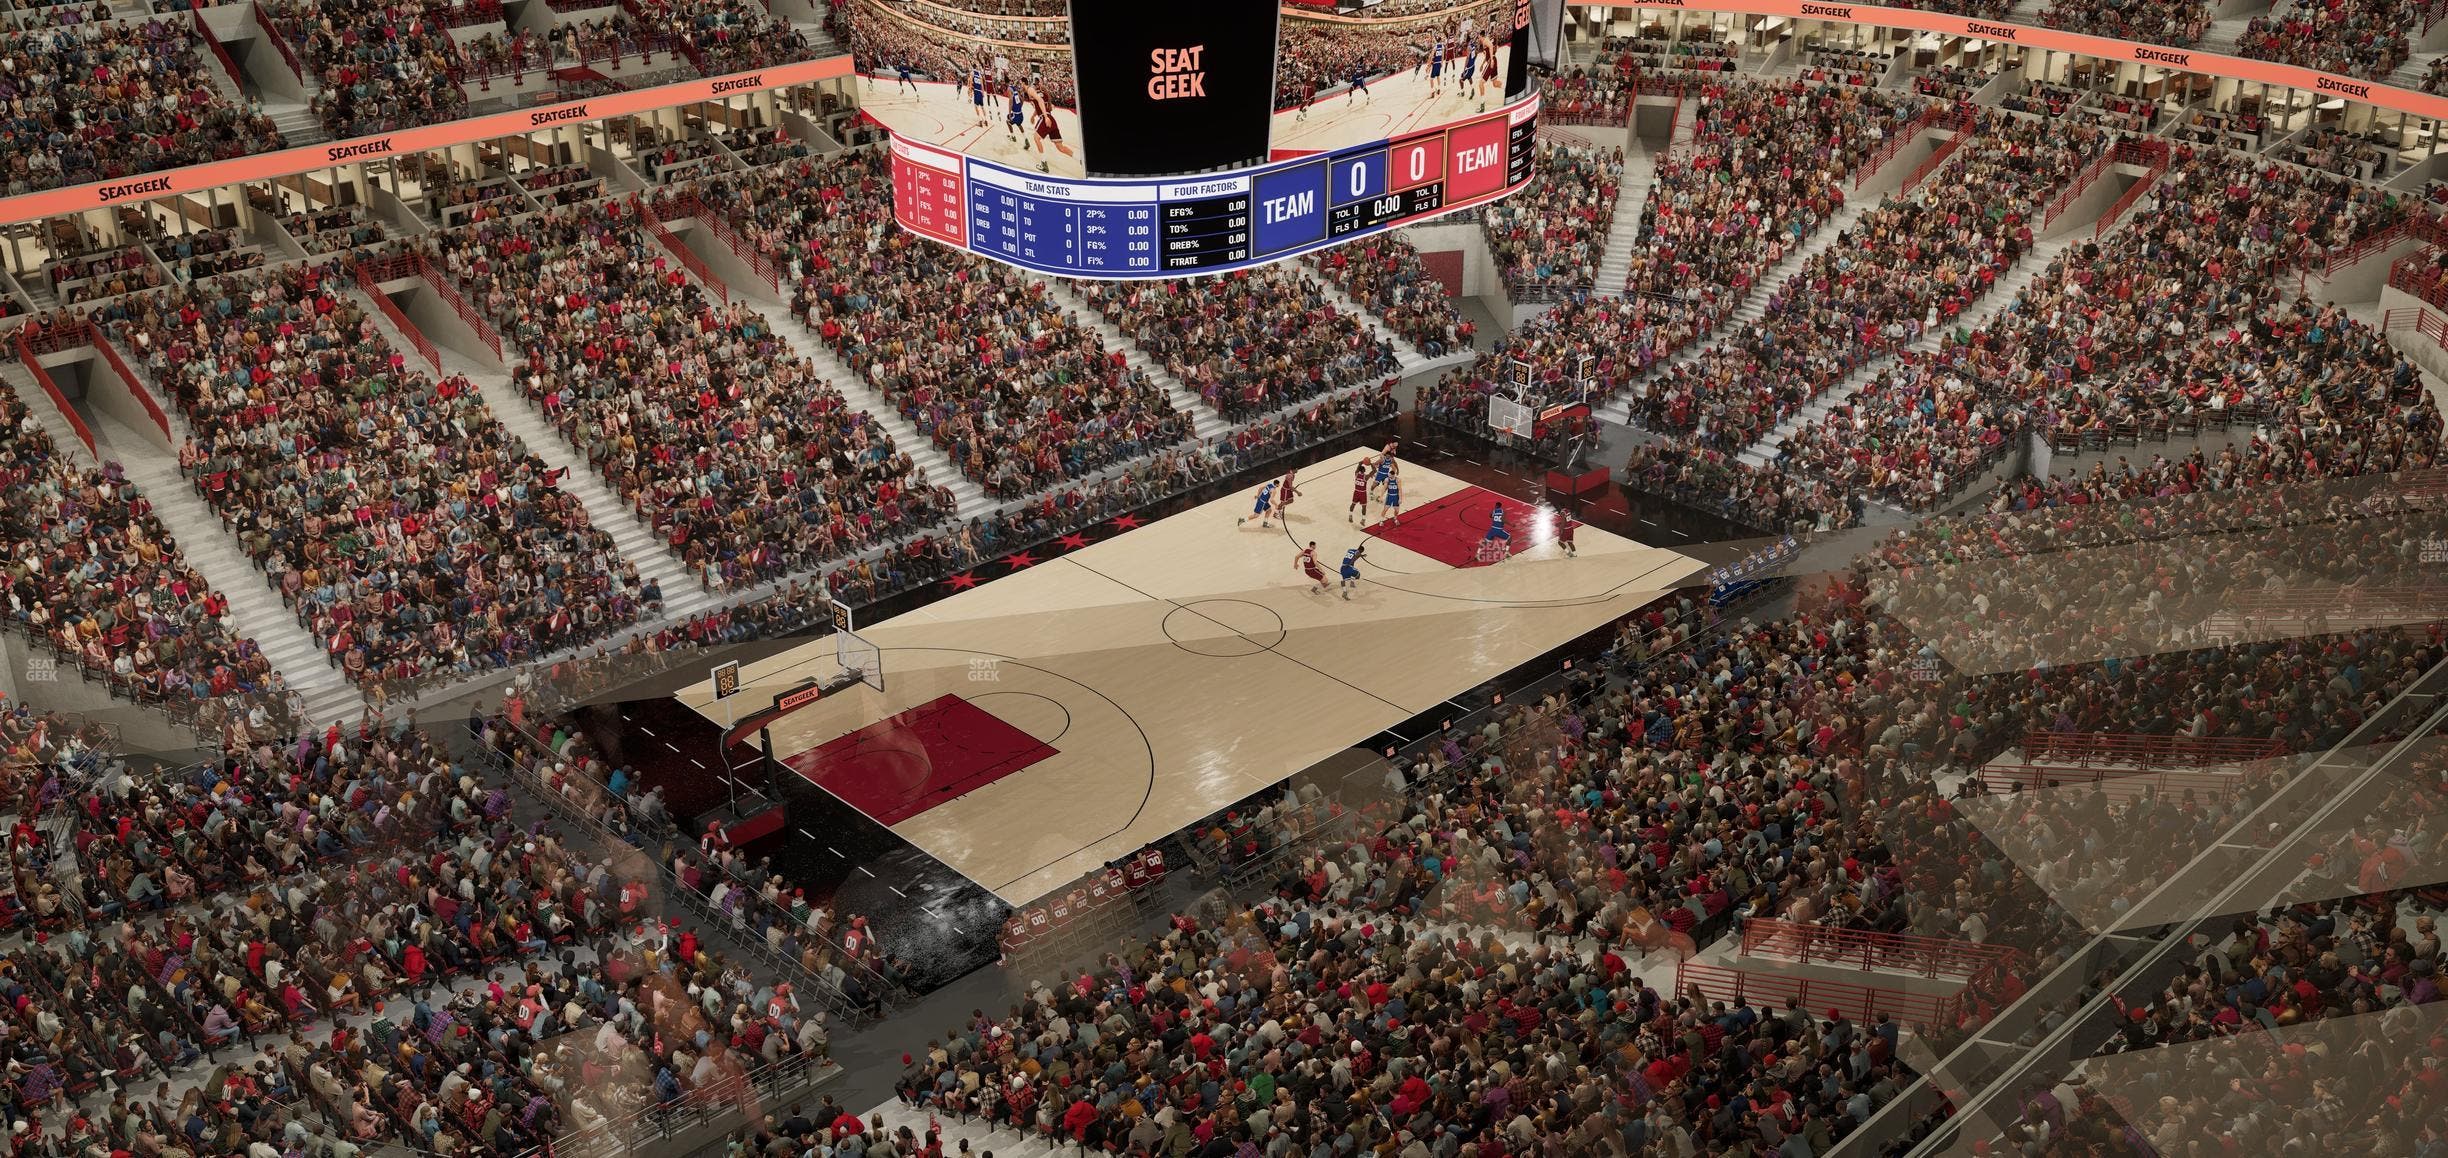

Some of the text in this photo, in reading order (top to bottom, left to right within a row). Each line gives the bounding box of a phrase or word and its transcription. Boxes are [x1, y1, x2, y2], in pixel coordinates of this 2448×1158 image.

[1801, 4, 1852, 18] SEATGEEK
[1967, 22, 2016, 40] SEATGEEK
[1151, 45, 1204, 74] SEAT
[2134, 48, 2190, 66] SEATGEEK
[712, 74, 762, 94] SEATGEEK
[1148, 72, 1206, 100] GEEK
[2316, 77, 2370, 99] SEATGEEK
[531, 104, 588, 126] SEATGEEK
[328, 138, 392, 162] SEATGEEK
[1410, 147, 1425, 181] 0
[1456, 143, 1498, 174] TEAM
[1351, 161, 1366, 196] 0
[98, 176, 172, 202] SEATGEEK
[1025, 181, 1070, 196] TEAM STATS
[1174, 181, 1238, 196] FOUR FACTORS
[1416, 185, 1437, 198] TOL 0
[975, 188, 1014, 207] AST 0.00
[1415, 198, 1437, 211] FLS 0
[1024, 201, 1071, 217] BLK 0
[1170, 200, 1246, 217] EFG% 0.00
[1263, 190, 1314, 224] TEAM
[1336, 205, 1359, 218] TOL 0
[1374, 195, 1400, 217] 0:00
[1001, 211, 1014, 222] 0.00
[1086, 210, 1148, 220] 2P% 0.00
[1002, 226, 1015, 238] 0.00
[1024, 216, 1071, 233] TO 0
[1087, 226, 1149, 235] 3P% 0.00
[1170, 217, 1246, 234] TO% 0.00
[1336, 219, 1358, 233] FLS 0
[976, 233, 1016, 253] STL 0.00
[1024, 232, 1072, 248] POT 0
[1087, 241, 1149, 251] FG% 0.00
[1170, 233, 1246, 250] OREB% 0.00
[1025, 248, 1072, 264] STL 0
[1129, 257, 1149, 266] 0.00
[1170, 249, 1246, 266] FTRATE 0.00
[783, 689, 815, 707] SEATGEEK
[1148, 855, 1161, 866] 00
[1110, 877, 1123, 888] 00
[1134, 869, 1145, 880] 00
[1093, 886, 1105, 897] 00
[1031, 914, 1046, 926] 00
[1055, 907, 1068, 918] 00
[1013, 925, 1025, 936] 00
[846, 936, 856, 950] 00
[519, 1005, 529, 1020] 00
[769, 1003, 780, 1019] 00
